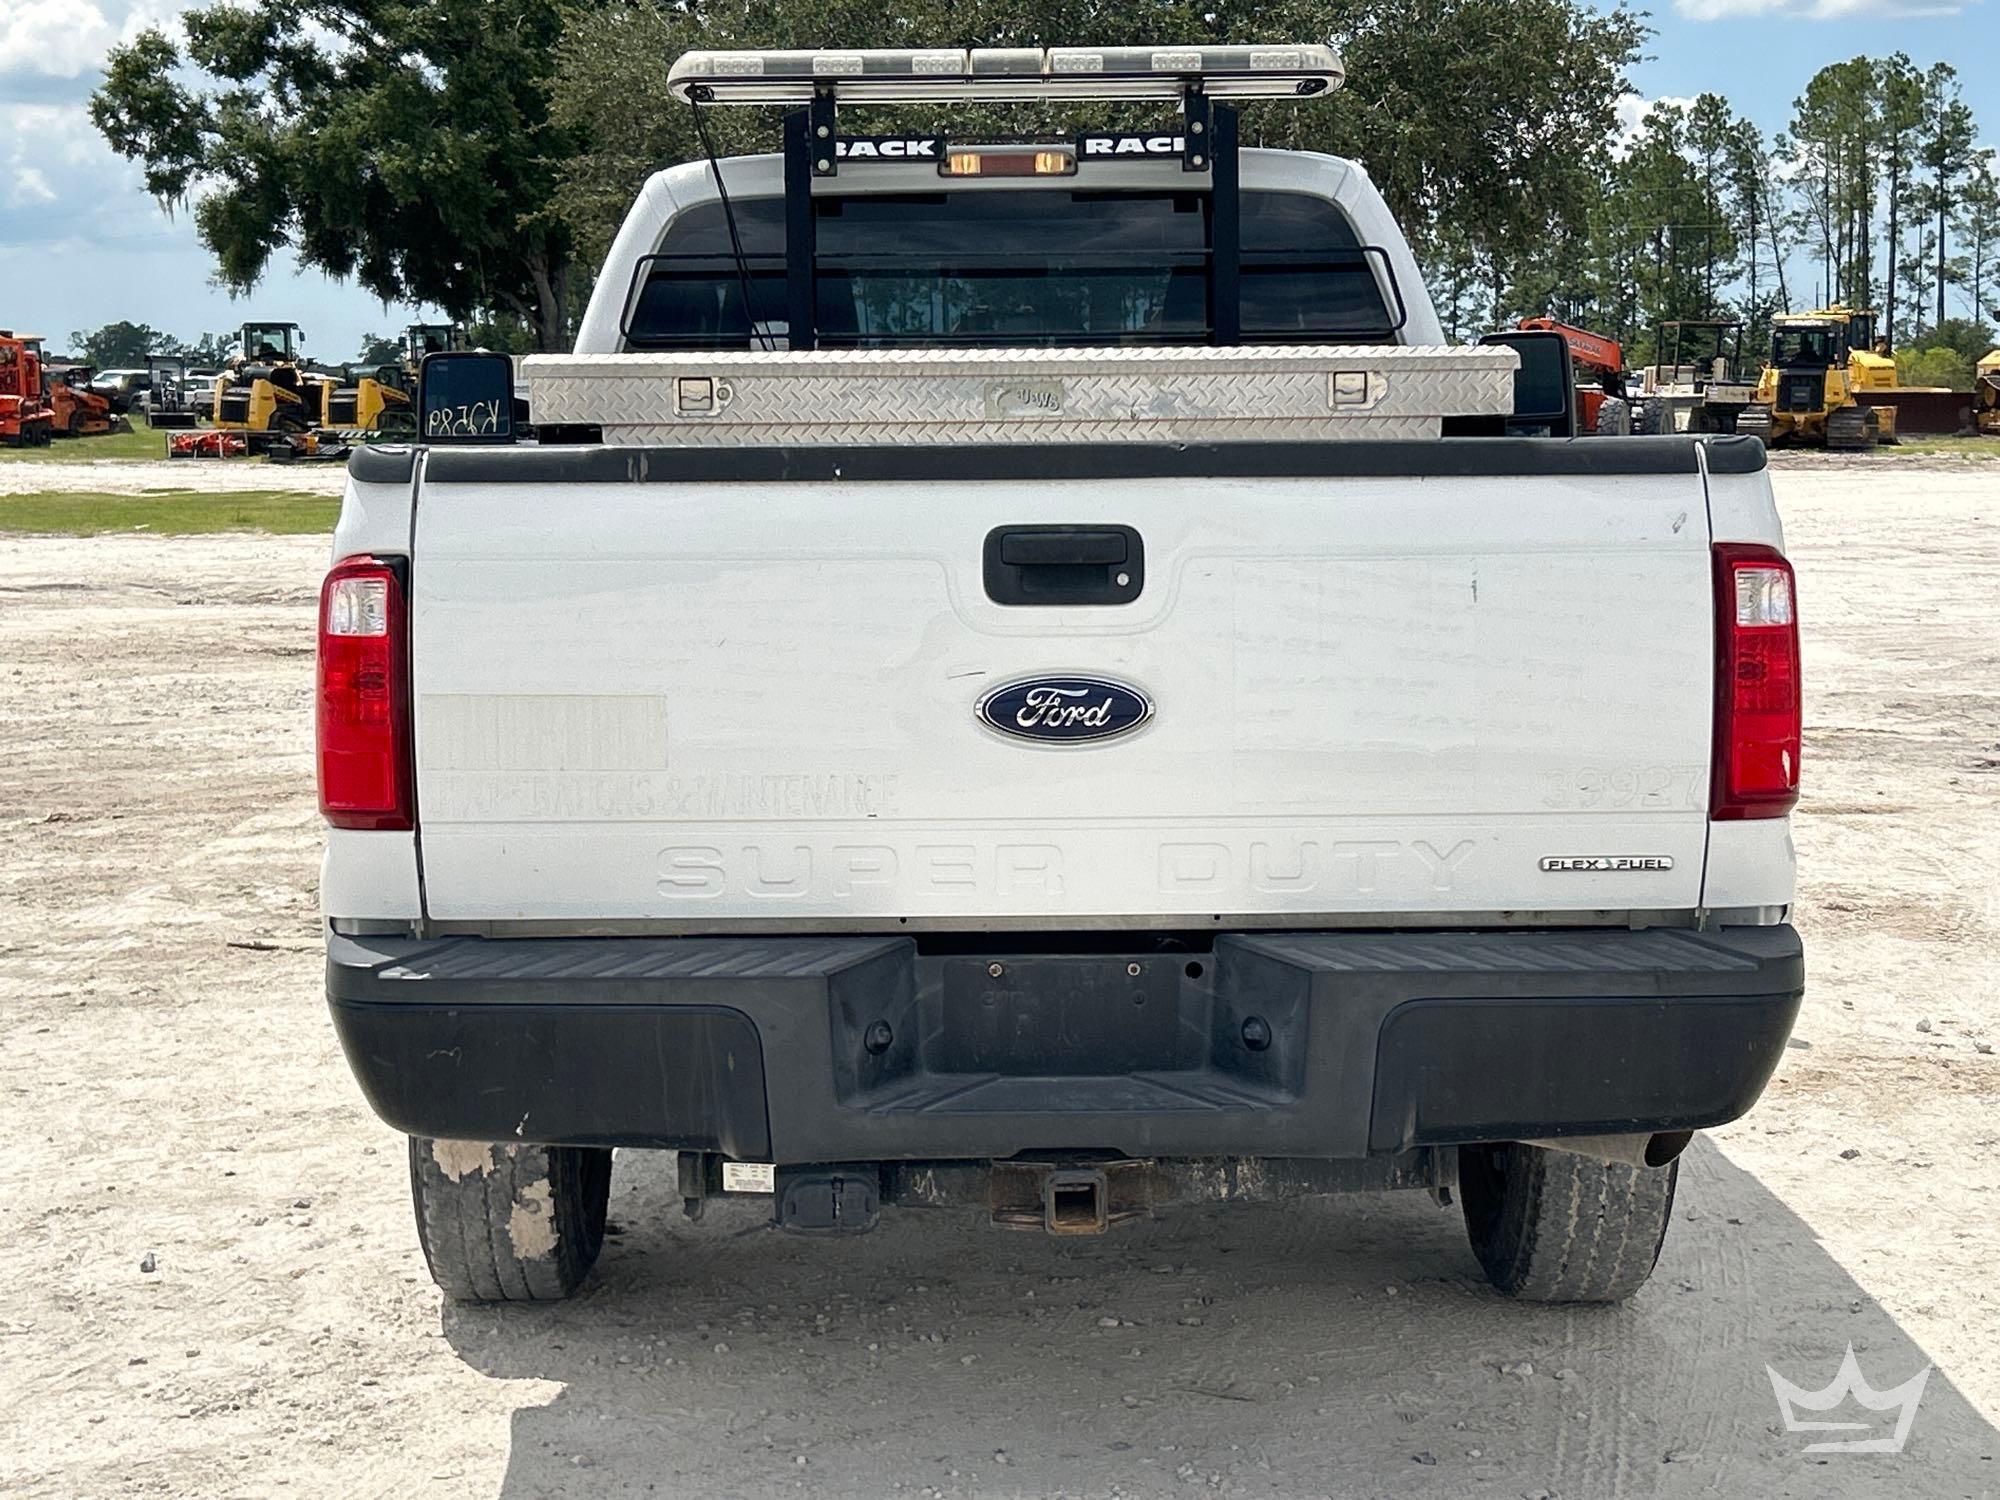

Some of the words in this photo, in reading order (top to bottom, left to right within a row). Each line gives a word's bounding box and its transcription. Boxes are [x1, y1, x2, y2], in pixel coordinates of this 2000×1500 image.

[1016, 687, 1113, 727] Ford
[657, 844, 1065, 898] SUPER
[1159, 840, 1476, 893] DUTY
[1549, 859, 1600, 870] FLEX
[1616, 858, 1669, 869] FUEL
